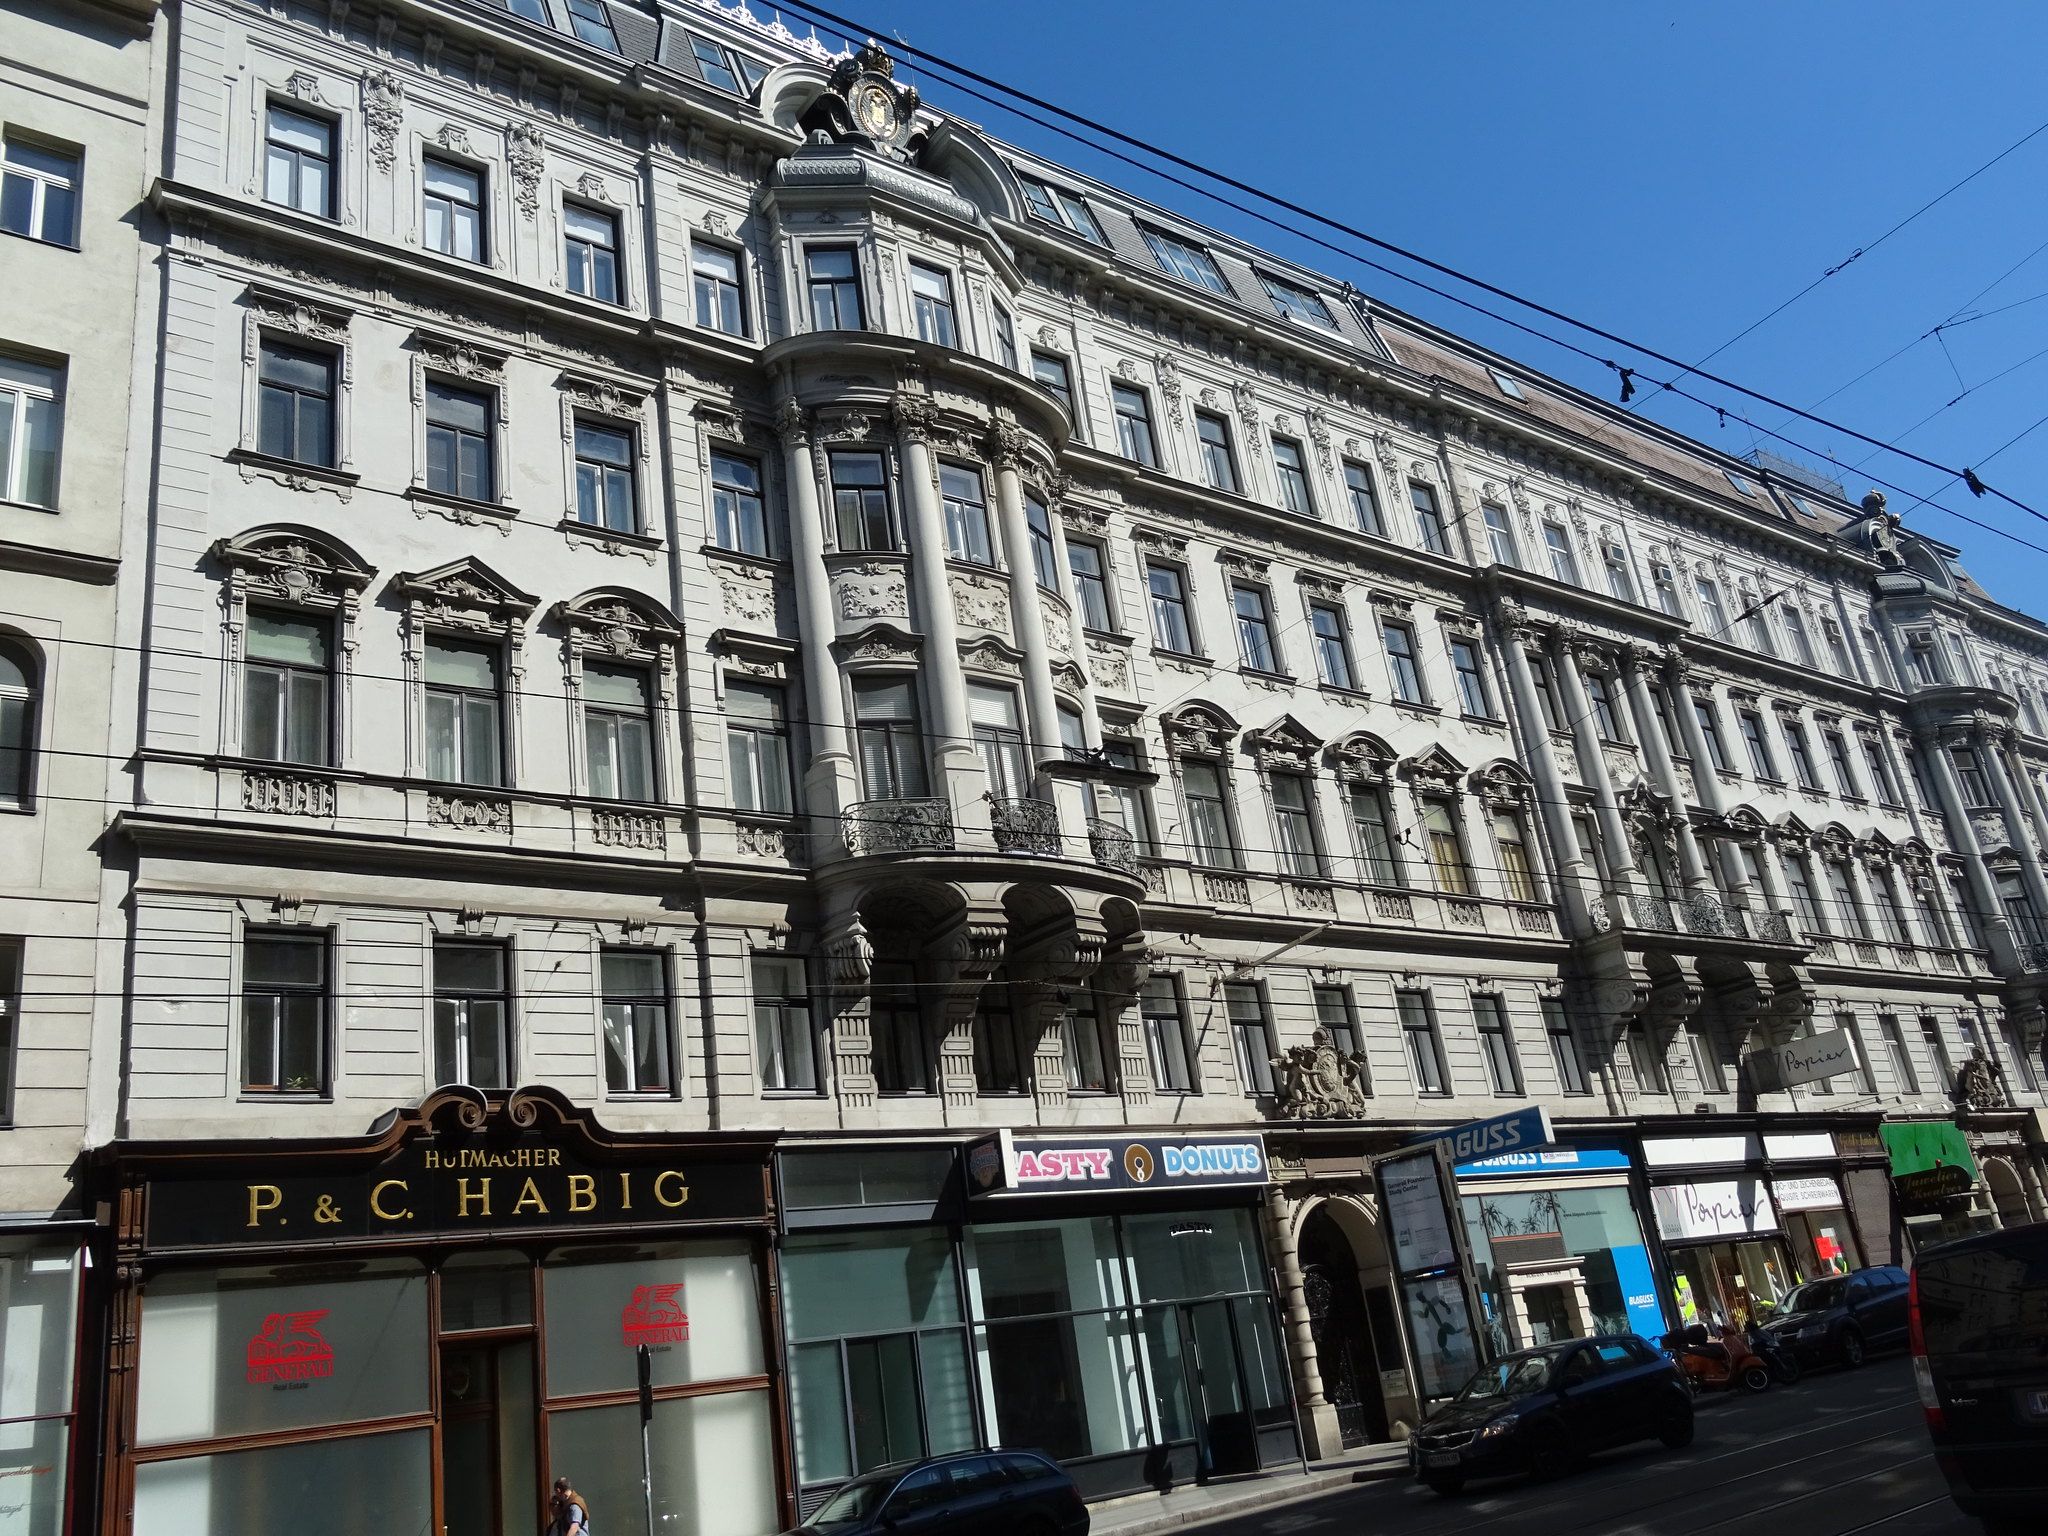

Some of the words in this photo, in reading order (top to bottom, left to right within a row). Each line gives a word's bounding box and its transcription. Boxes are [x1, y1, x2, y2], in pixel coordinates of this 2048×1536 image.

[1784, 1047, 1847, 1072] Papier
[424, 1148, 561, 1168] HUTMACHER
[1016, 1149, 1112, 1181] ASTY
[1162, 1144, 1262, 1177] DONUTS
[246, 1184, 288, 1227] P.
[313, 1194, 343, 1223] &
[370, 1179, 414, 1220] C.
[456, 1170, 690, 1217] HABIG
[1684, 1180, 1764, 1234] Papier
[1169, 1221, 1213, 1237] TASTY
[1628, 1294, 1655, 1306] BLAGUSS
[623, 1326, 690, 1348] GENERALI
[246, 1358, 334, 1385] GENERALI
